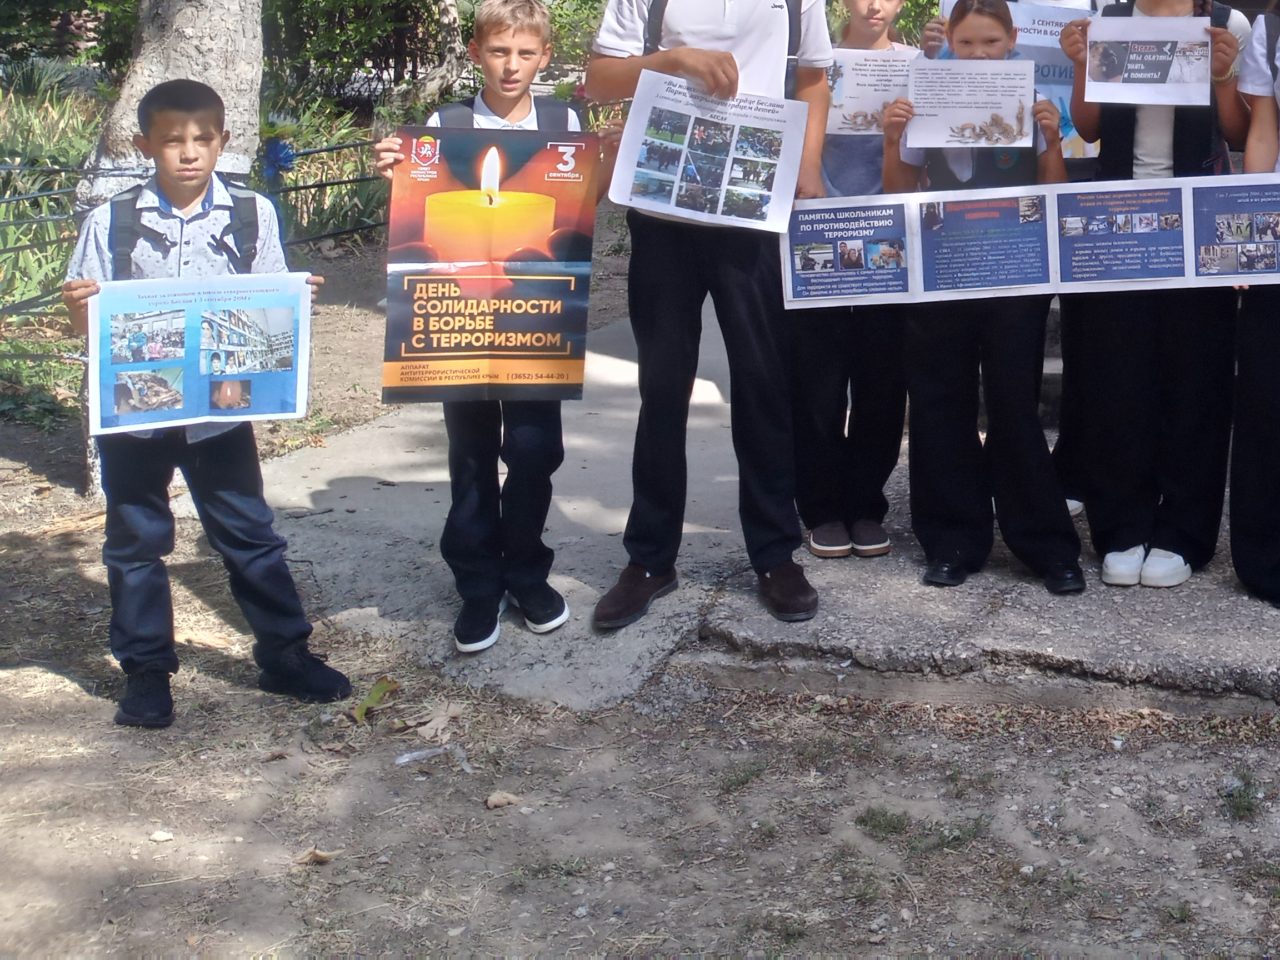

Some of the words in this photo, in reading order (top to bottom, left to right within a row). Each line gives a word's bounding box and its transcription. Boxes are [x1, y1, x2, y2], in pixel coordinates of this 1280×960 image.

[1129, 53, 1141, 61] Мы
[556, 145, 576, 172] 3
[798, 213, 835, 222] ПАМЯТКА
[836, 208, 894, 219] ШКОЛЬНИКАМ
[800, 224, 812, 232] ПО
[813, 219, 893, 231] ПРОТИВОДЕЙСТВИЮ
[823, 228, 875, 239] ТЕРРОРИЗМУ
[413, 282, 461, 300] ДЕНЬ
[413, 298, 562, 316] СОЛИДАРНОСТИ
[412, 316, 425, 332] В
[428, 315, 495, 331] БОРЬБЕ
[411, 333, 426, 349] С
[429, 331, 561, 349] ТЕРРОРИЗМОМ
[399, 367, 481, 377] АНТИТЕРРОРИСТИЧЕСКОЙ
[400, 363, 430, 371] АППАРАТ
[399, 374, 438, 382] КОМИССИИ
[534, 372, 566, 380] 54-44-20
